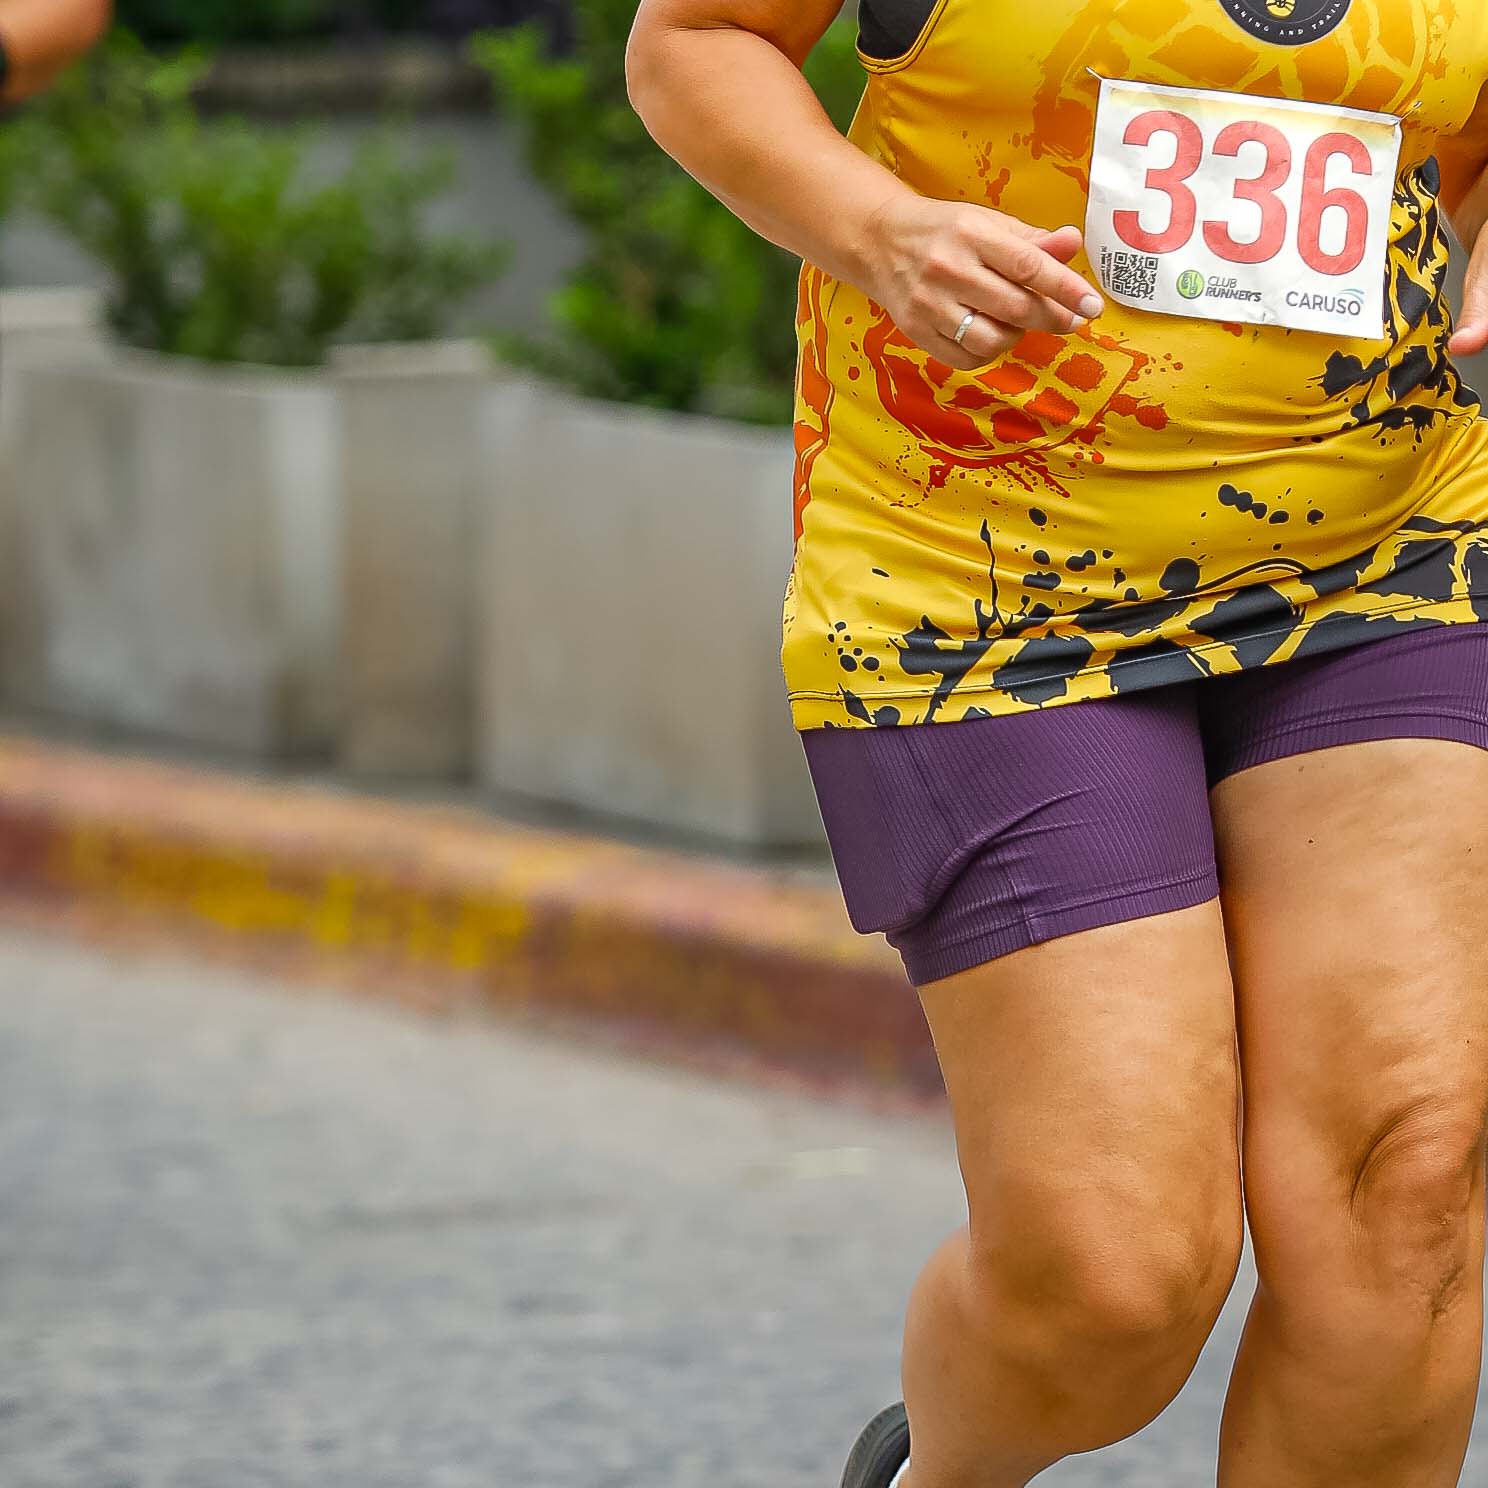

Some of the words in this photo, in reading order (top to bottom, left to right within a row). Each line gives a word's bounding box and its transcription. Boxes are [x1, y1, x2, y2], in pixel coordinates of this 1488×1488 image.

[1113, 110, 1372, 276] 336
[1207, 275, 1239, 289] CLUB
[1285, 290, 1362, 316] CARUSO
